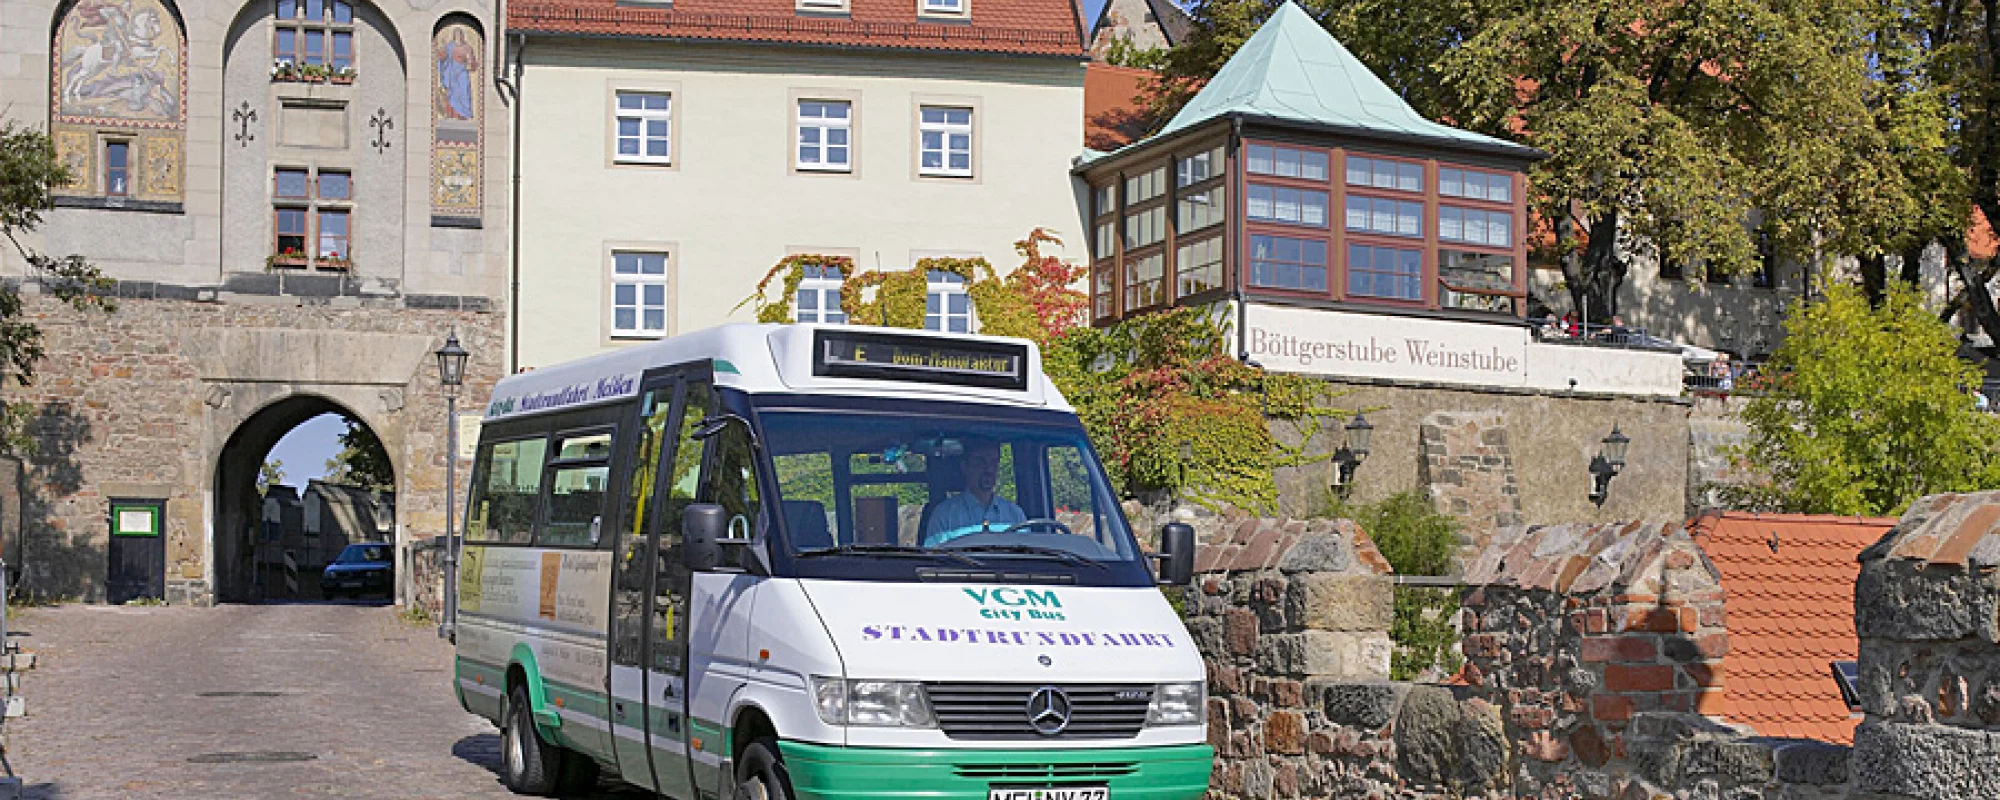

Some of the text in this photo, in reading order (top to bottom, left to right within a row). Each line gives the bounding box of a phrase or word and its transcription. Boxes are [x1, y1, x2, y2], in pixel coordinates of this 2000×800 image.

[1250, 326, 1519, 373] Böttgerstube Weinstube
[962, 586, 1063, 608] VGM
[979, 608, 1066, 621] City Bus
[861, 624, 1176, 648] STADTRUNDFAHRT
